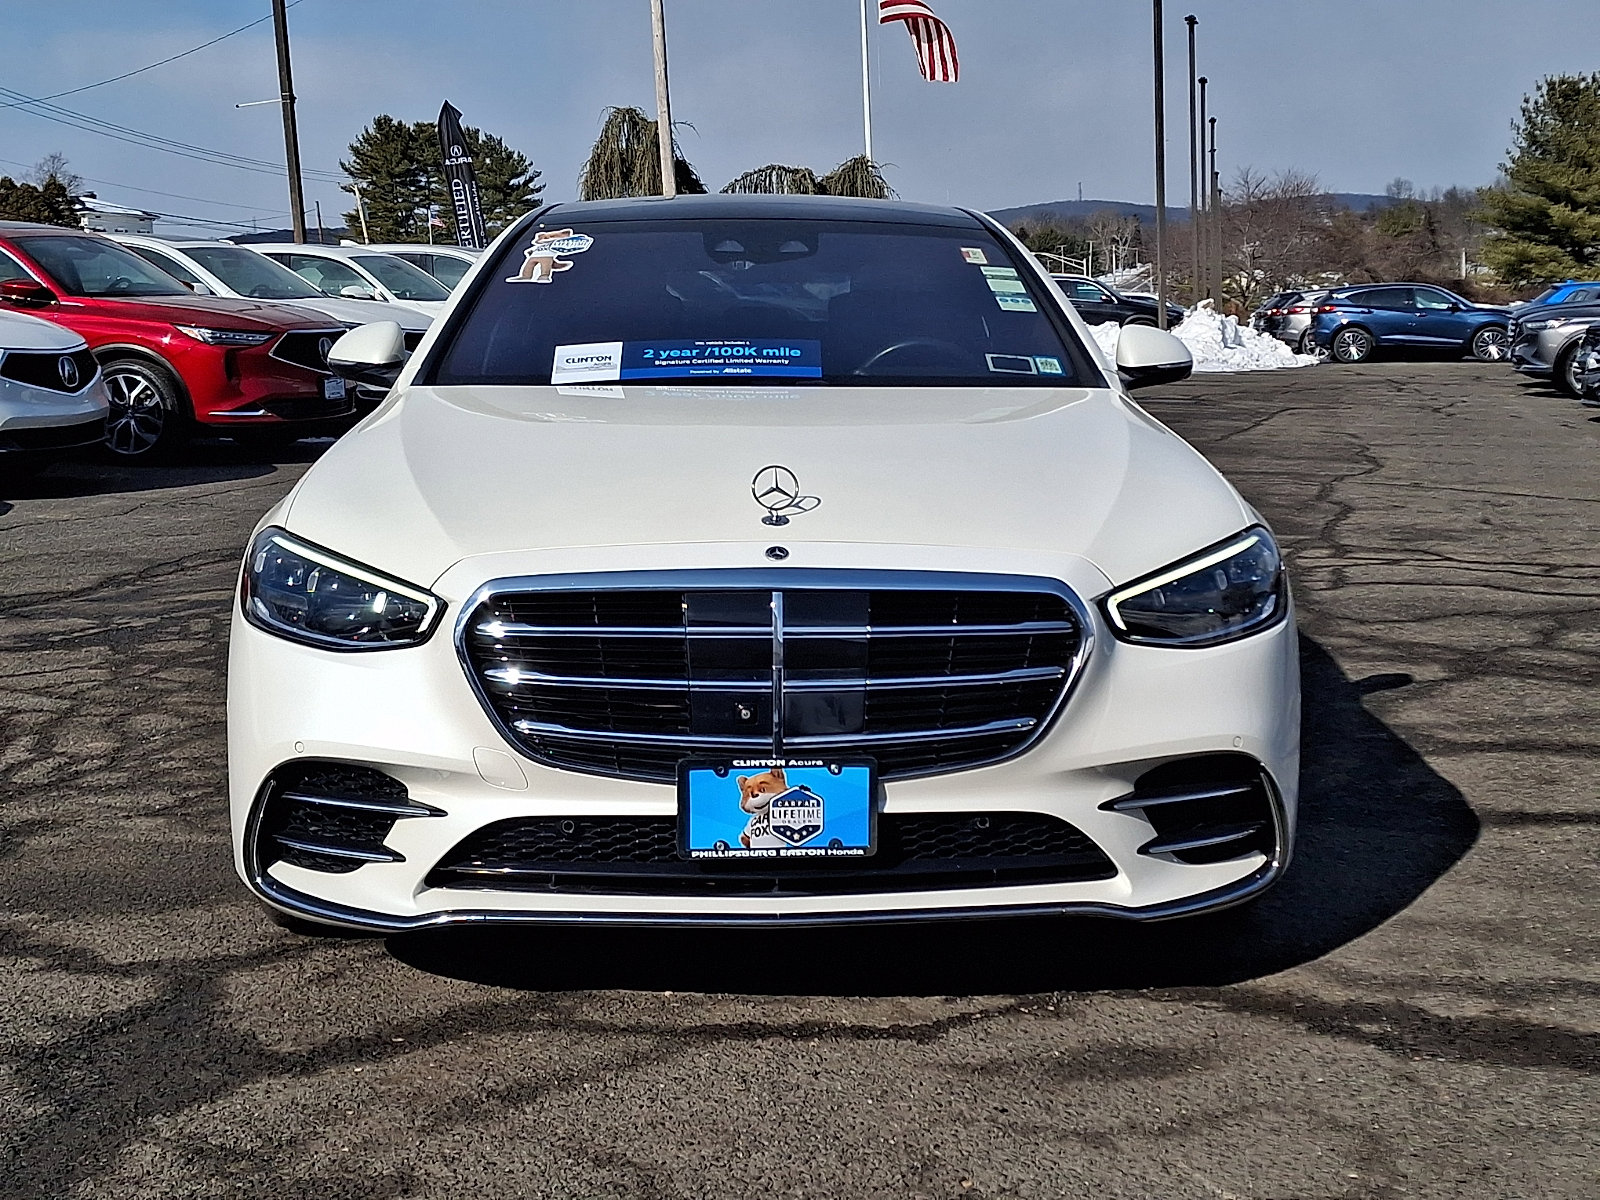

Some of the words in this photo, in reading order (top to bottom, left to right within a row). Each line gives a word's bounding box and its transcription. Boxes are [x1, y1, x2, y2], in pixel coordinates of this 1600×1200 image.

[444, 156, 472, 166] ACURA
[452, 178, 474, 248] ERTIFIED
[642, 349, 654, 358] 2
[659, 349, 700, 359] year
[704, 346, 758, 356] /100K
[762, 347, 802, 356] mile
[565, 356, 612, 364] CLINTON
[732, 759, 786, 767] CLINTON
[777, 799, 818, 808] CARFAX
[772, 809, 822, 820] LIFETIME
[750, 825, 770, 838] FOX
[691, 850, 777, 858] PHILLIPSBURG
[780, 849, 826, 858] EASTON
[827, 848, 865, 856] Honda
